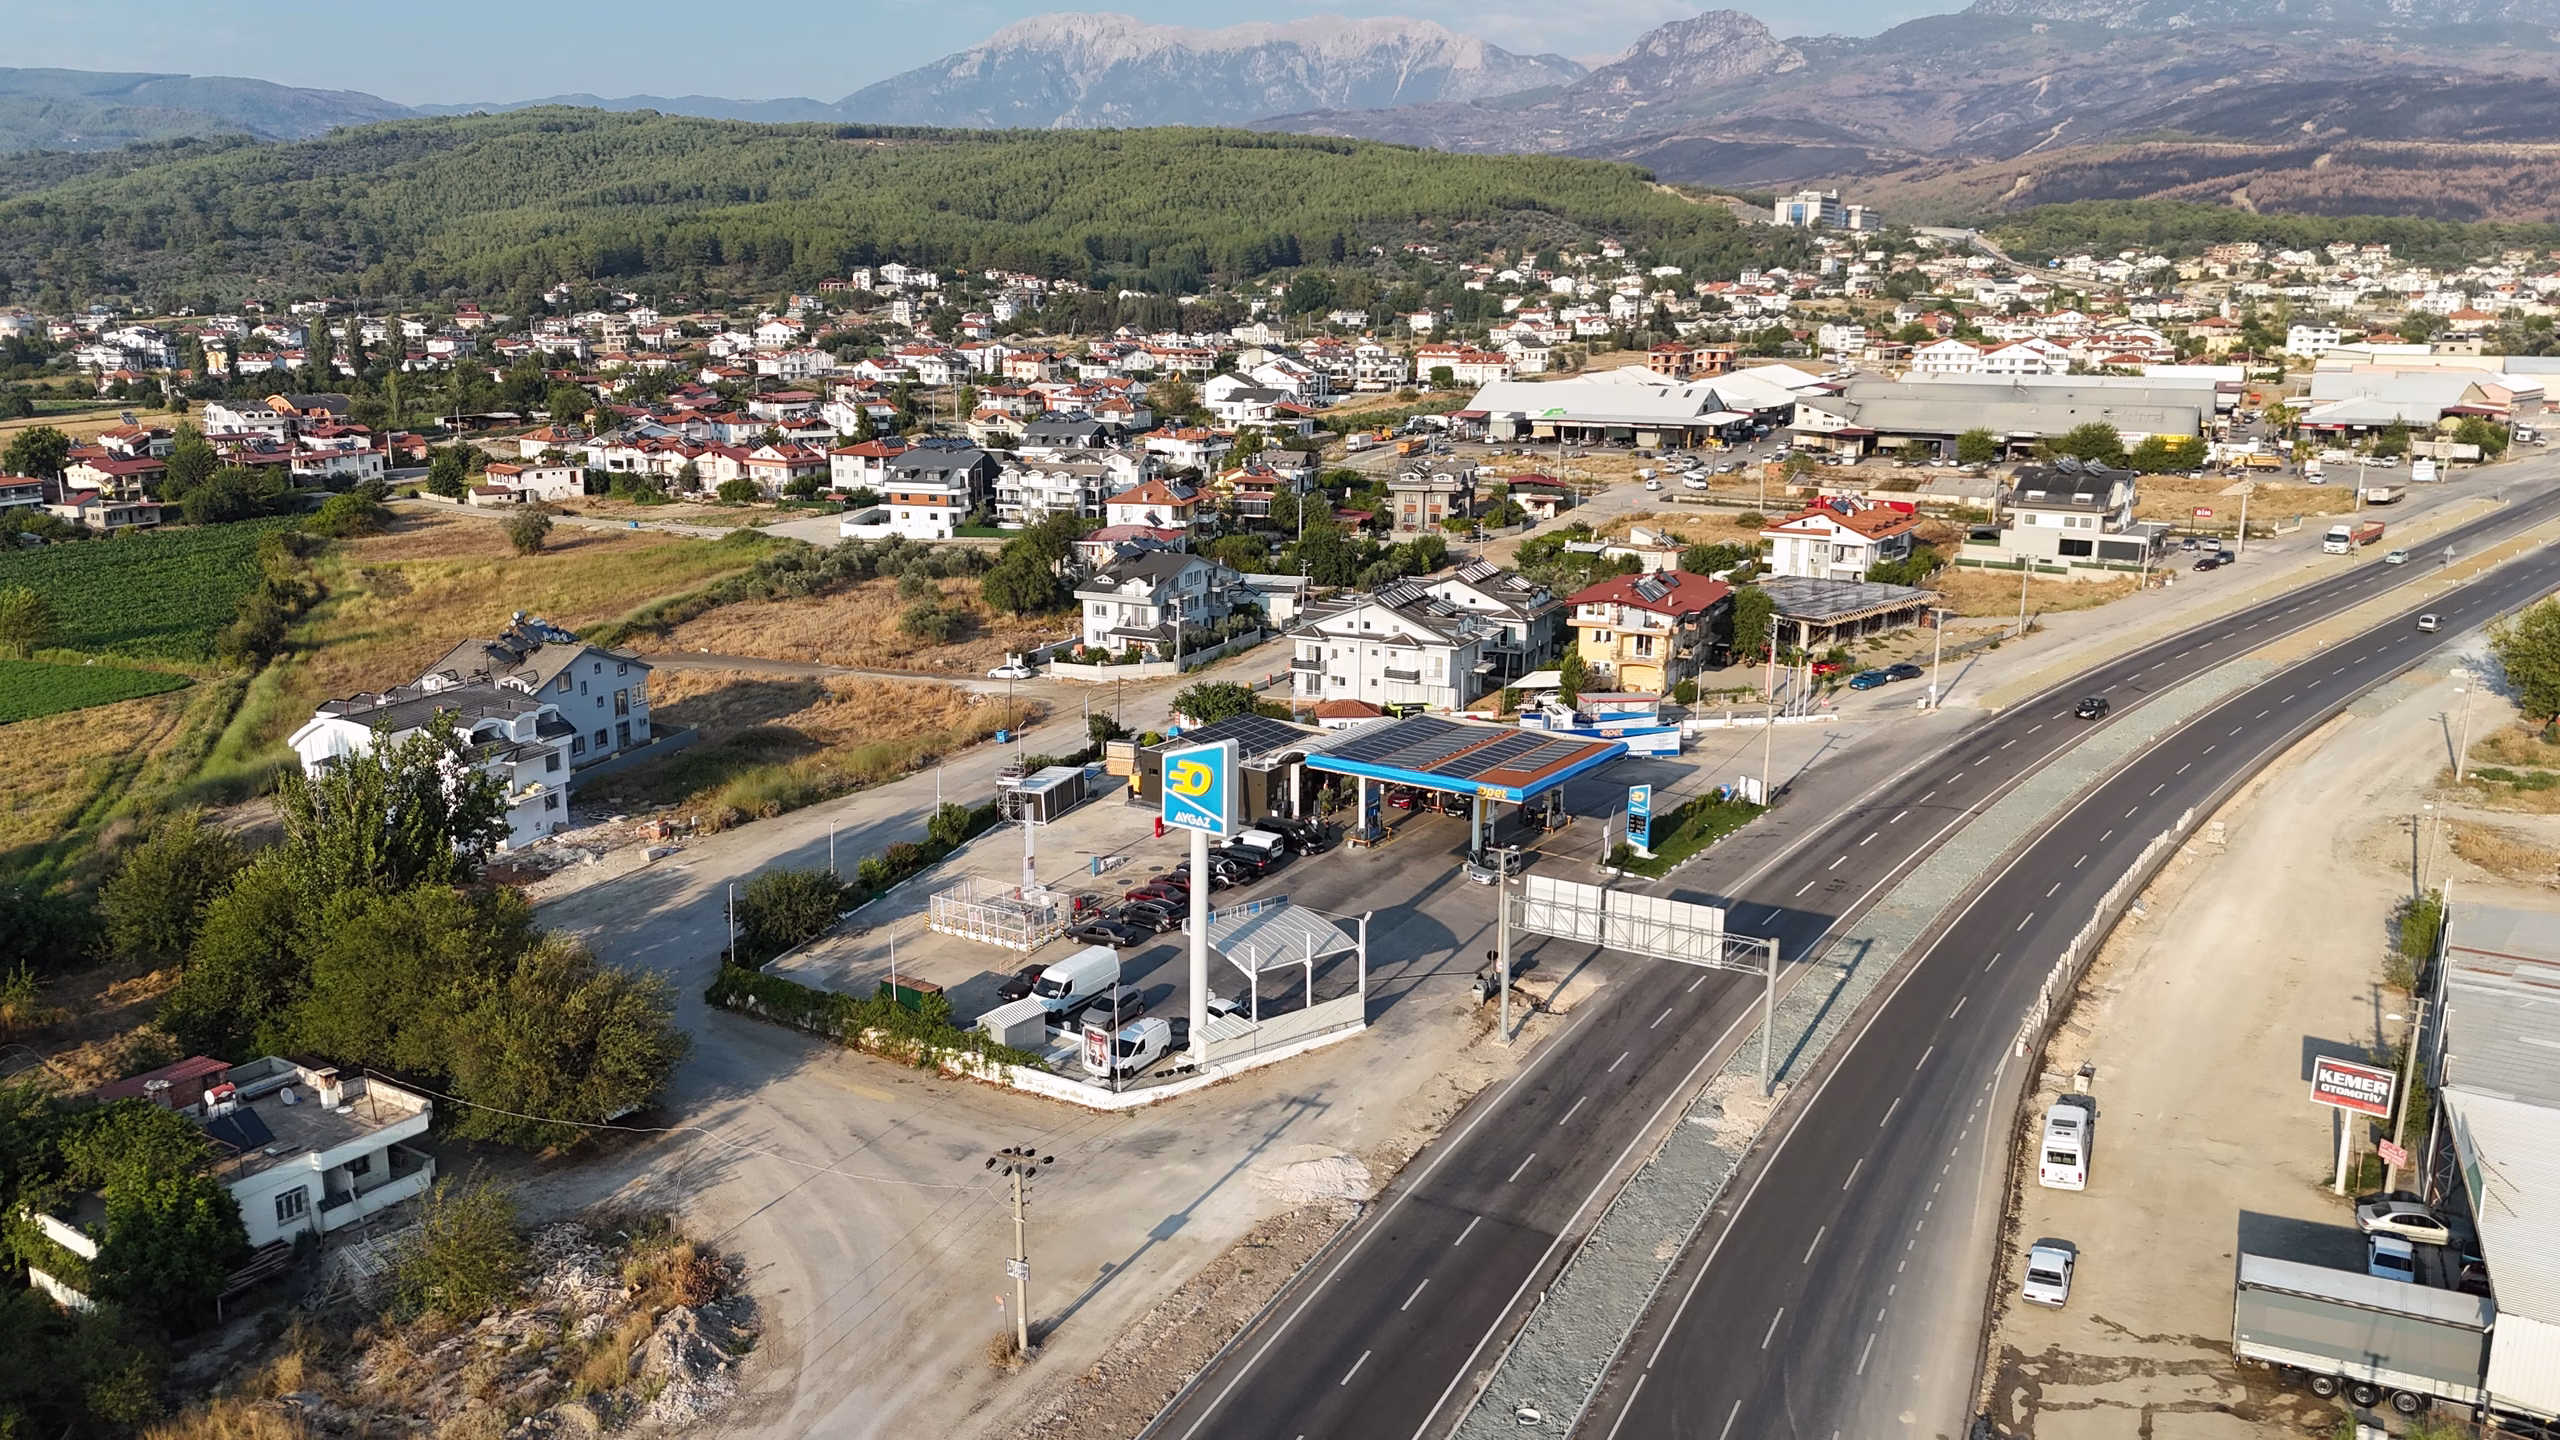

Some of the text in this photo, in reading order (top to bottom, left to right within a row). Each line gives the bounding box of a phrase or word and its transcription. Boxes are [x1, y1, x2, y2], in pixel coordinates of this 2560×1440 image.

[2196, 508, 2211, 516] BİM
[1477, 786, 1507, 799] opet
[1174, 811, 1211, 828] AYGAZ
[2319, 1069, 2388, 1095] KEMER
[2321, 1083, 2382, 1103] OTOMOTİV
